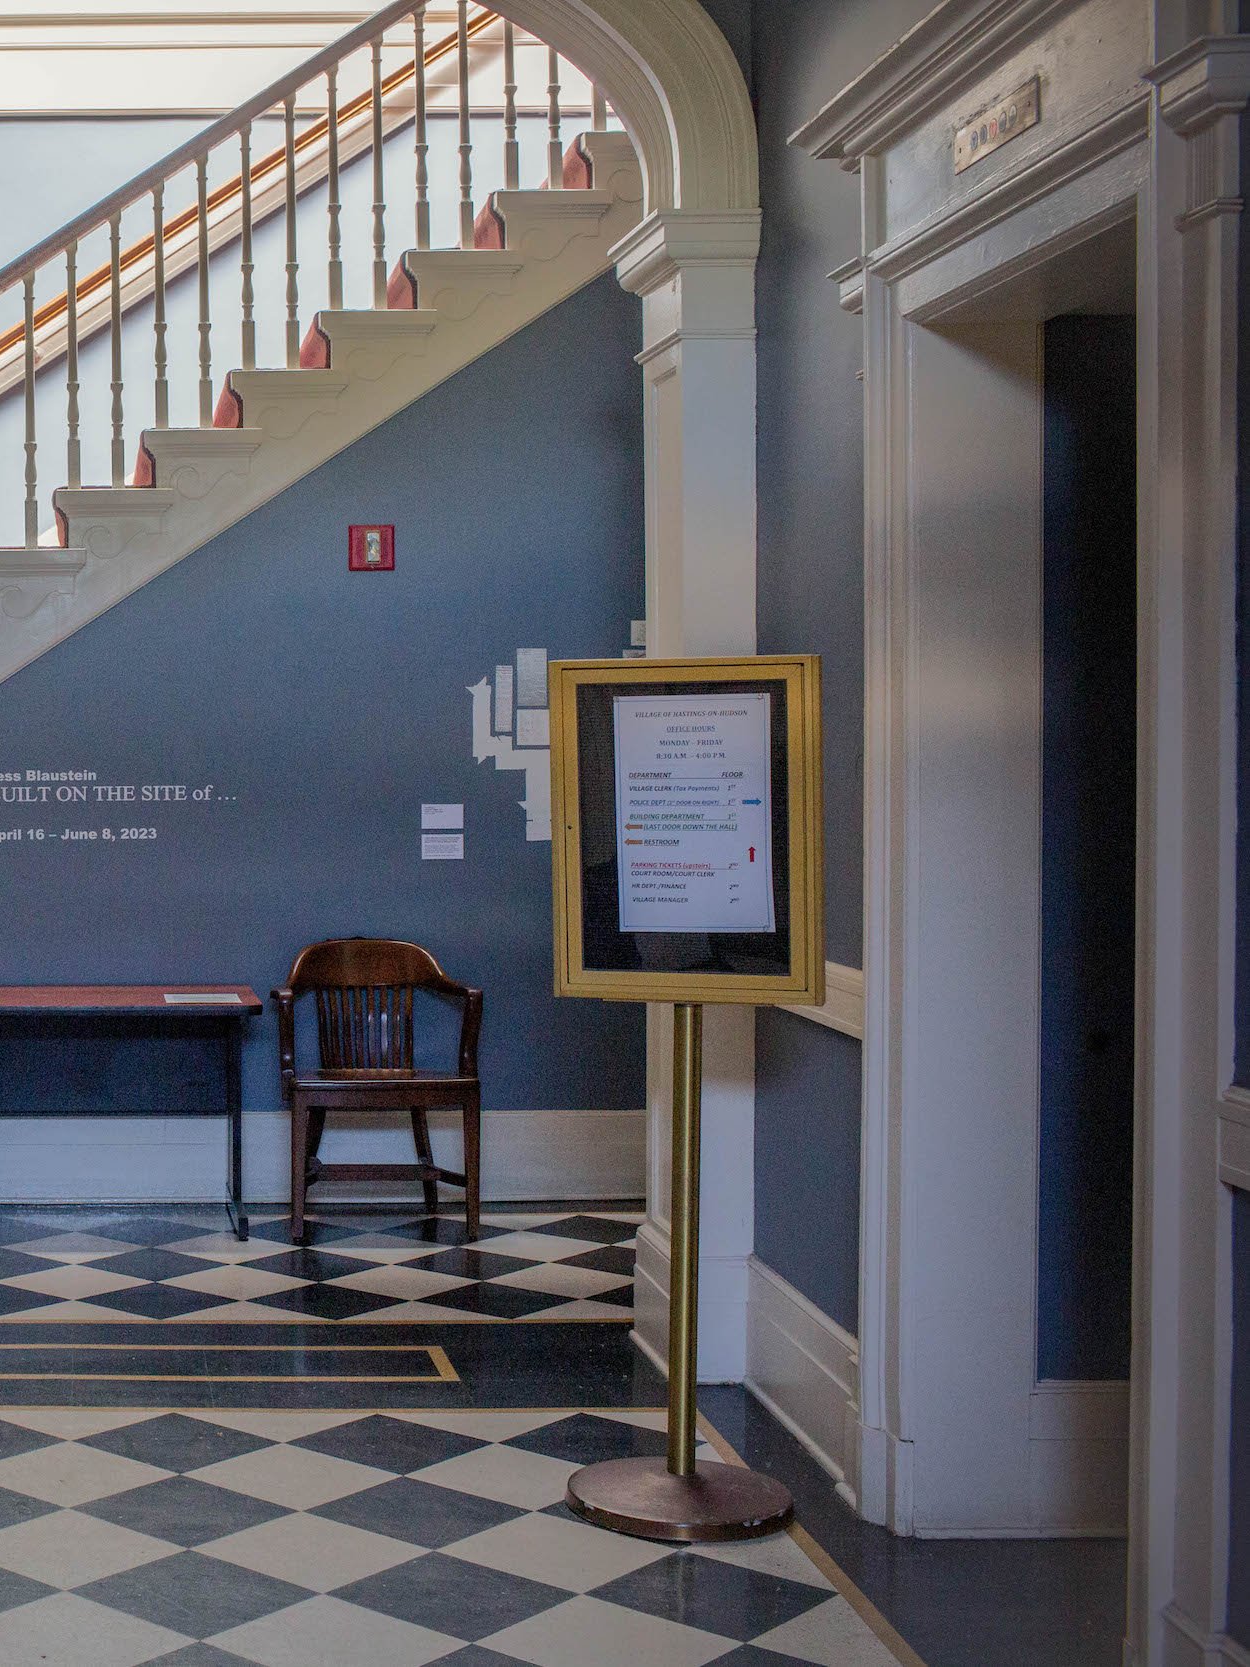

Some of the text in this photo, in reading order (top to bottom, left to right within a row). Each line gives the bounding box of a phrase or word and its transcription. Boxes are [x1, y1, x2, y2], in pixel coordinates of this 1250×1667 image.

[26, 770, 97, 782] Blaustein
[56, 786, 88, 802] ON
[93, 786, 136, 802] THE
[142, 786, 186, 801] SITE
[192, 785, 214, 801] of
[27, 828, 45, 840] 16
[61, 828, 98, 840] June
[102, 828, 116, 842] 8,
[120, 828, 158, 840] 2023
